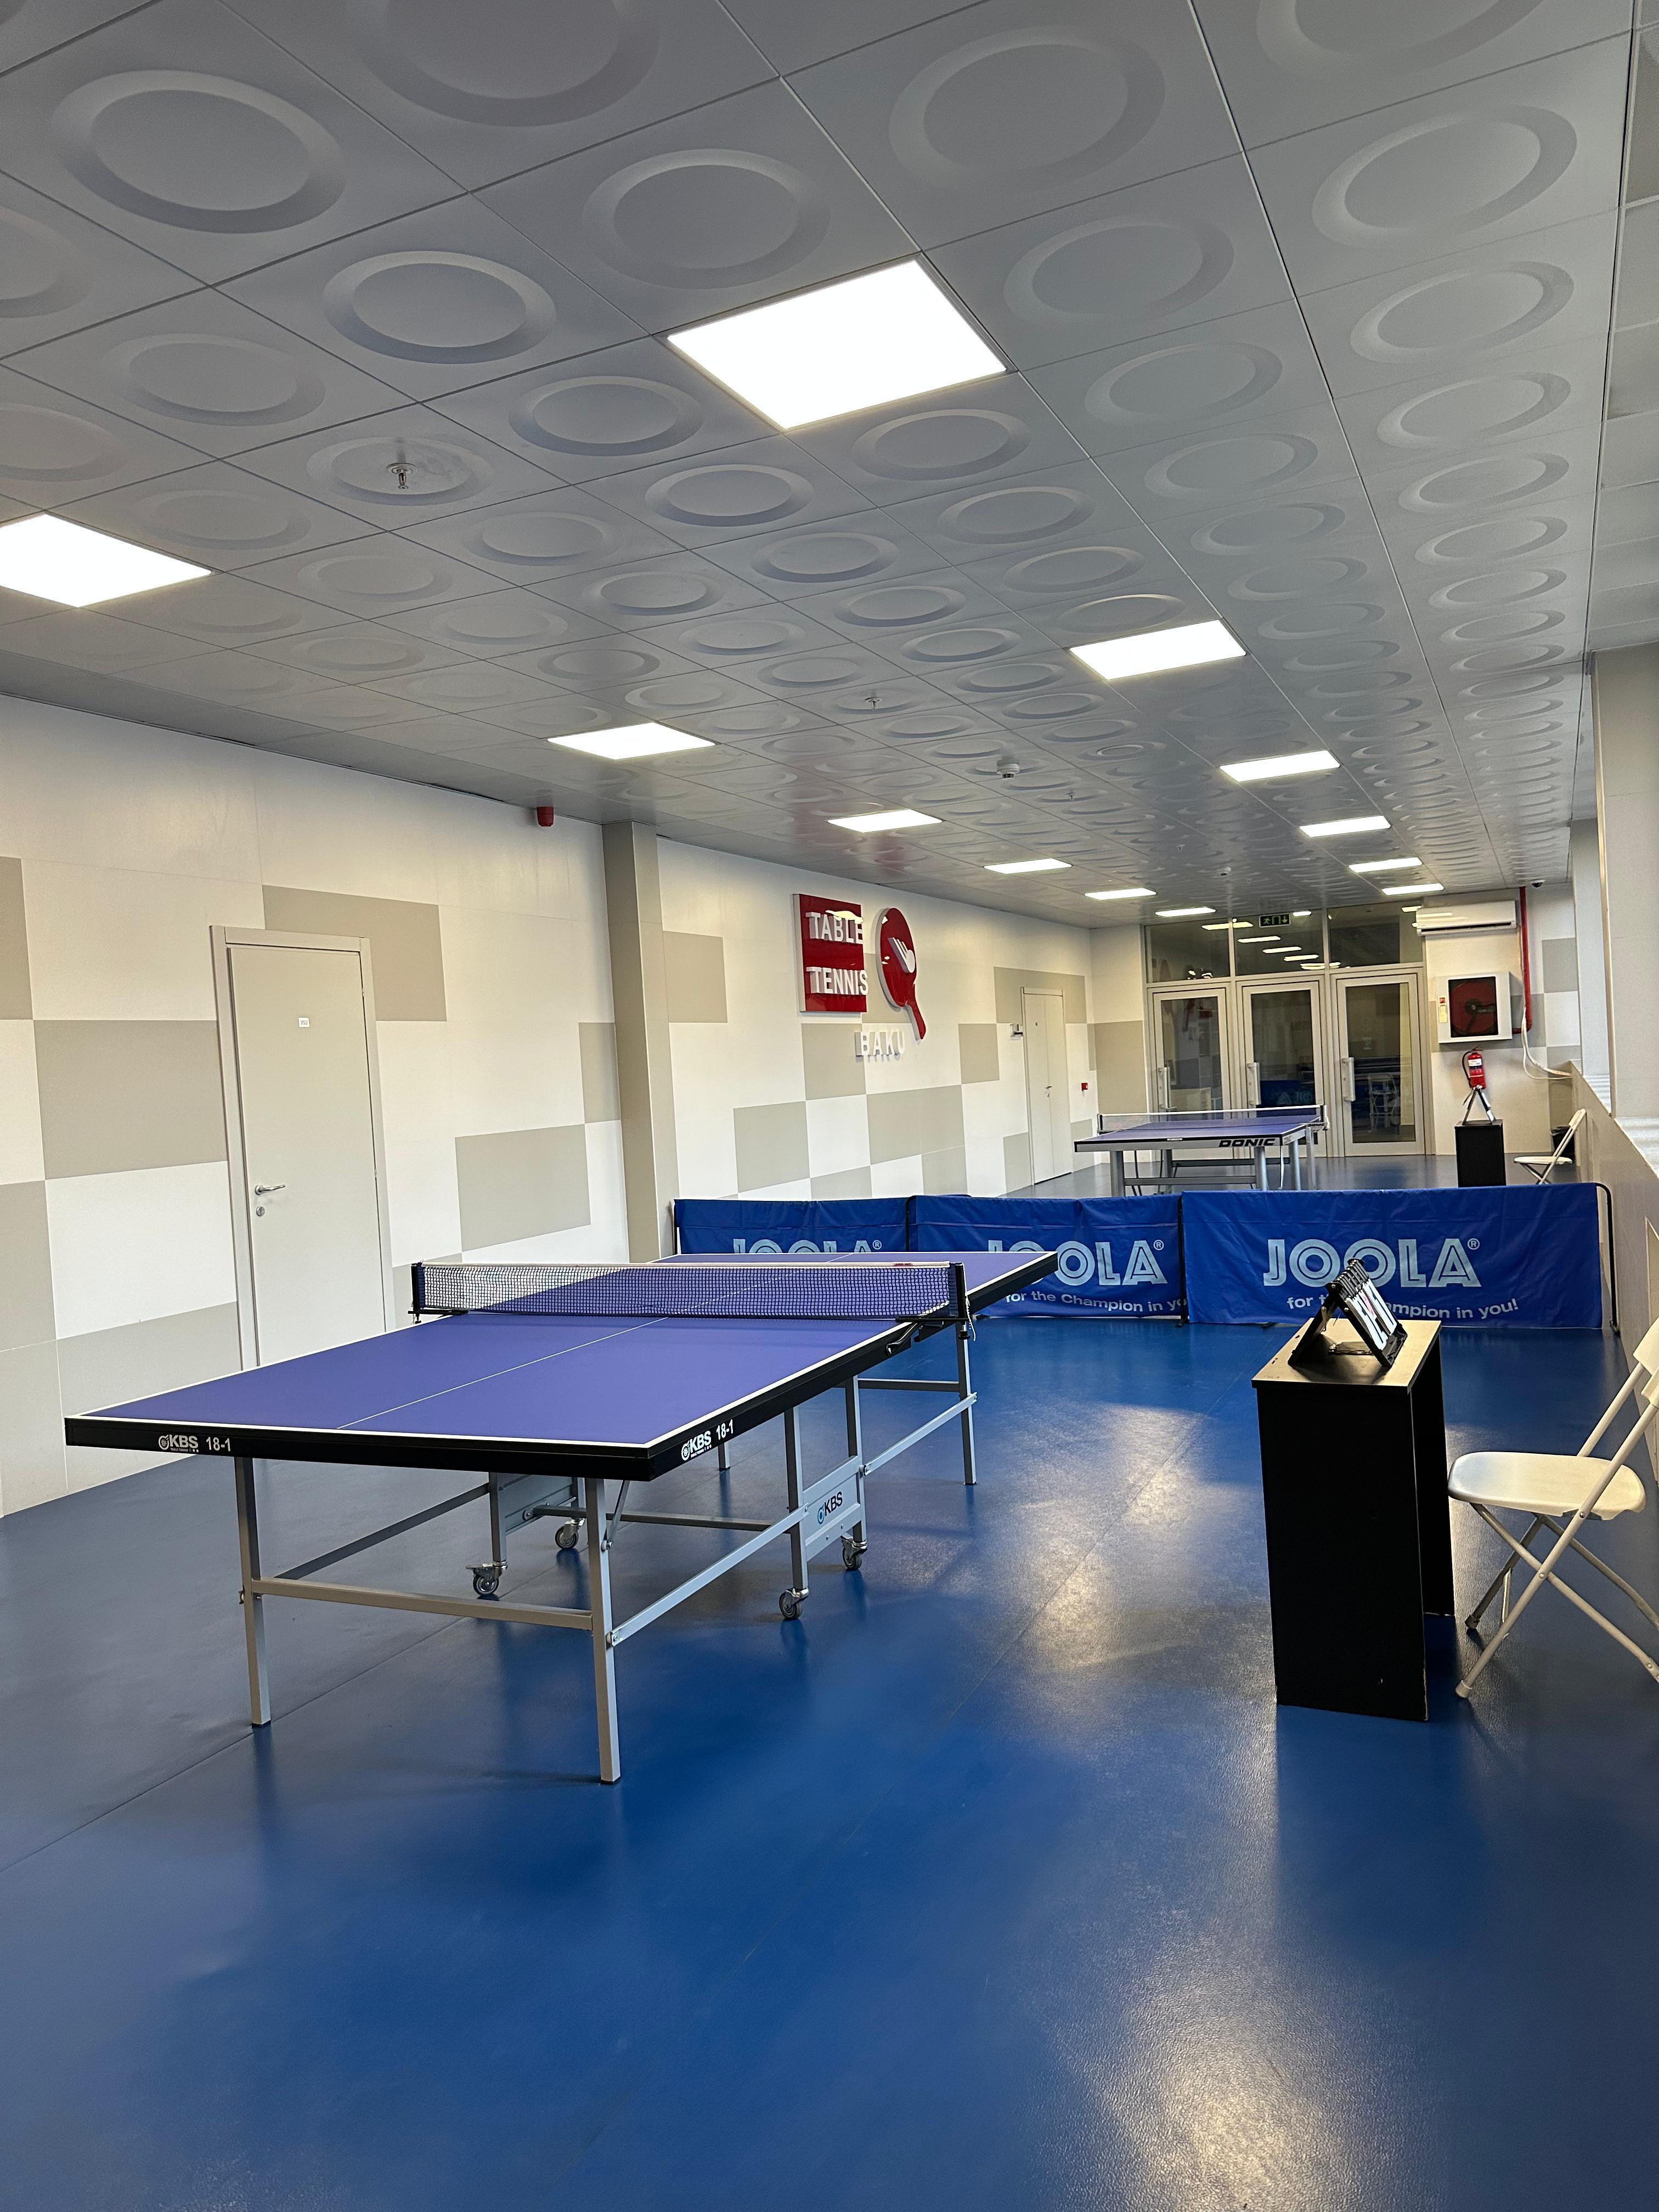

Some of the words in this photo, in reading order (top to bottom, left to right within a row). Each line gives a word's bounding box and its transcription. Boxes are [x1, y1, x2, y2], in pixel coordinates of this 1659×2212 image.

[805, 912, 863, 944] TABLE
[806, 967, 868, 995] TENNIS
[858, 1031, 905, 1056] BAKU
[1218, 1138, 1276, 1147] DONIC
[1031, 1291, 1056, 1301] the
[1061, 1294, 1143, 1312] Champion
[1148, 1301, 1163, 1311] in
[1286, 1296, 1313, 1310] for
[1456, 1307, 1473, 1318] in
[1480, 1298, 1519, 1319] you!
[170, 1434, 199, 1449] KBS
[206, 1436, 231, 1452] 18-1
[690, 1430, 712, 1453] KBS
[716, 1419, 733, 1440] 18-1
[824, 1491, 843, 1516] KBS
